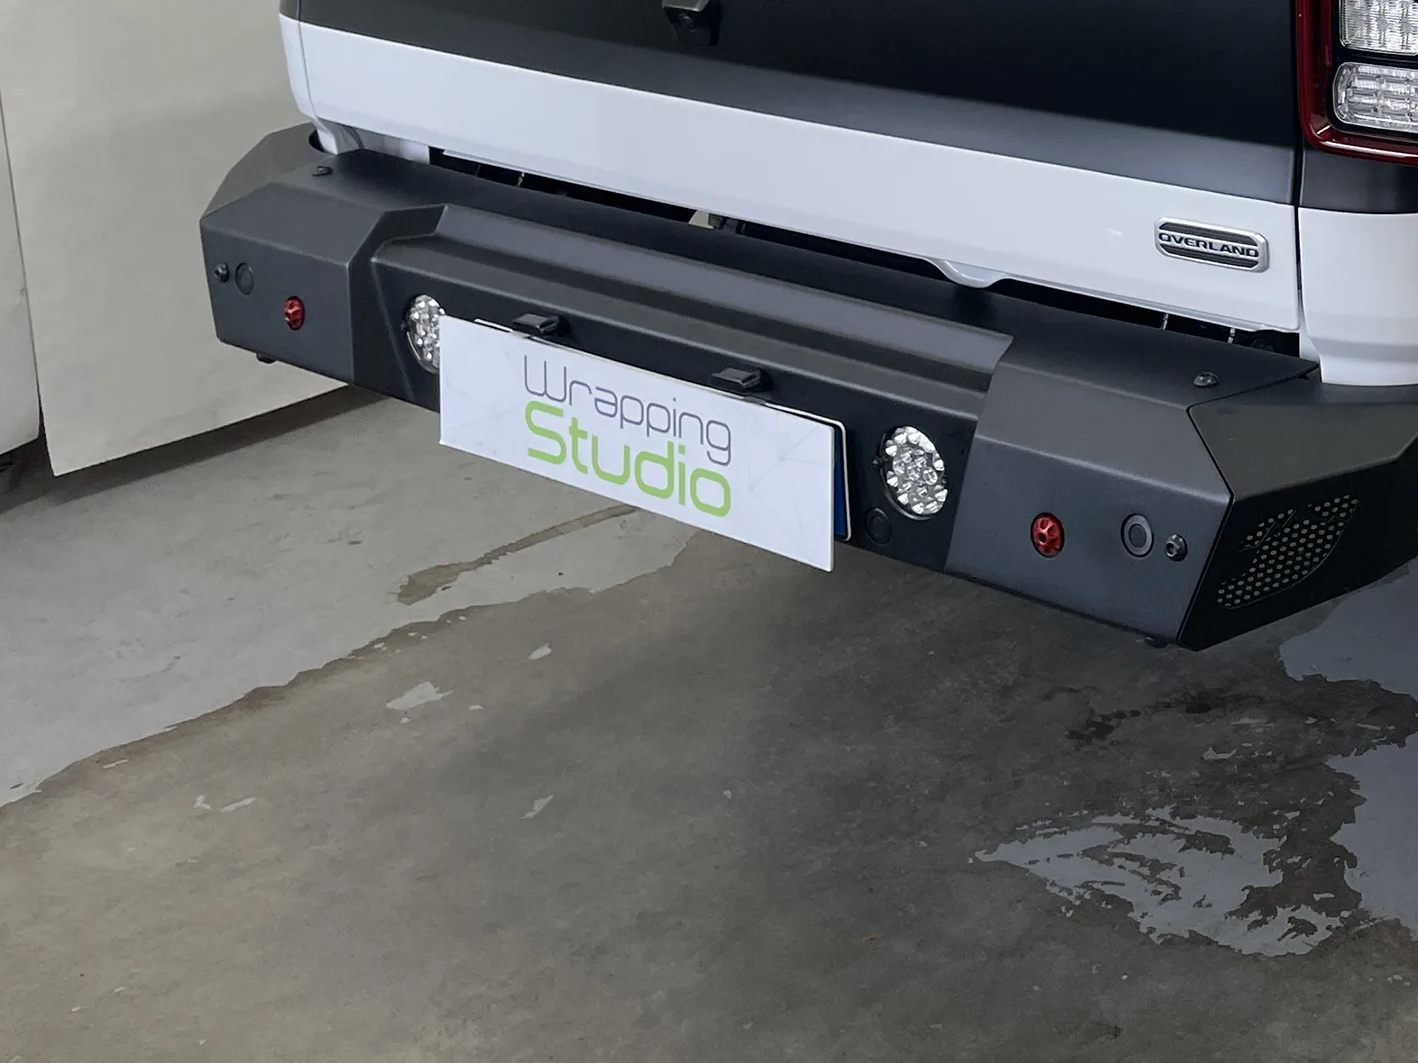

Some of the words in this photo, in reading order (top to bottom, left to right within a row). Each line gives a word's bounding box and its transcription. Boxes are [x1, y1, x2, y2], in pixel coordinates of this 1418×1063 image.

[1158, 232, 1260, 258] OVERLAND
[524, 354, 732, 467] Wrapping
[524, 400, 732, 518] Studio
